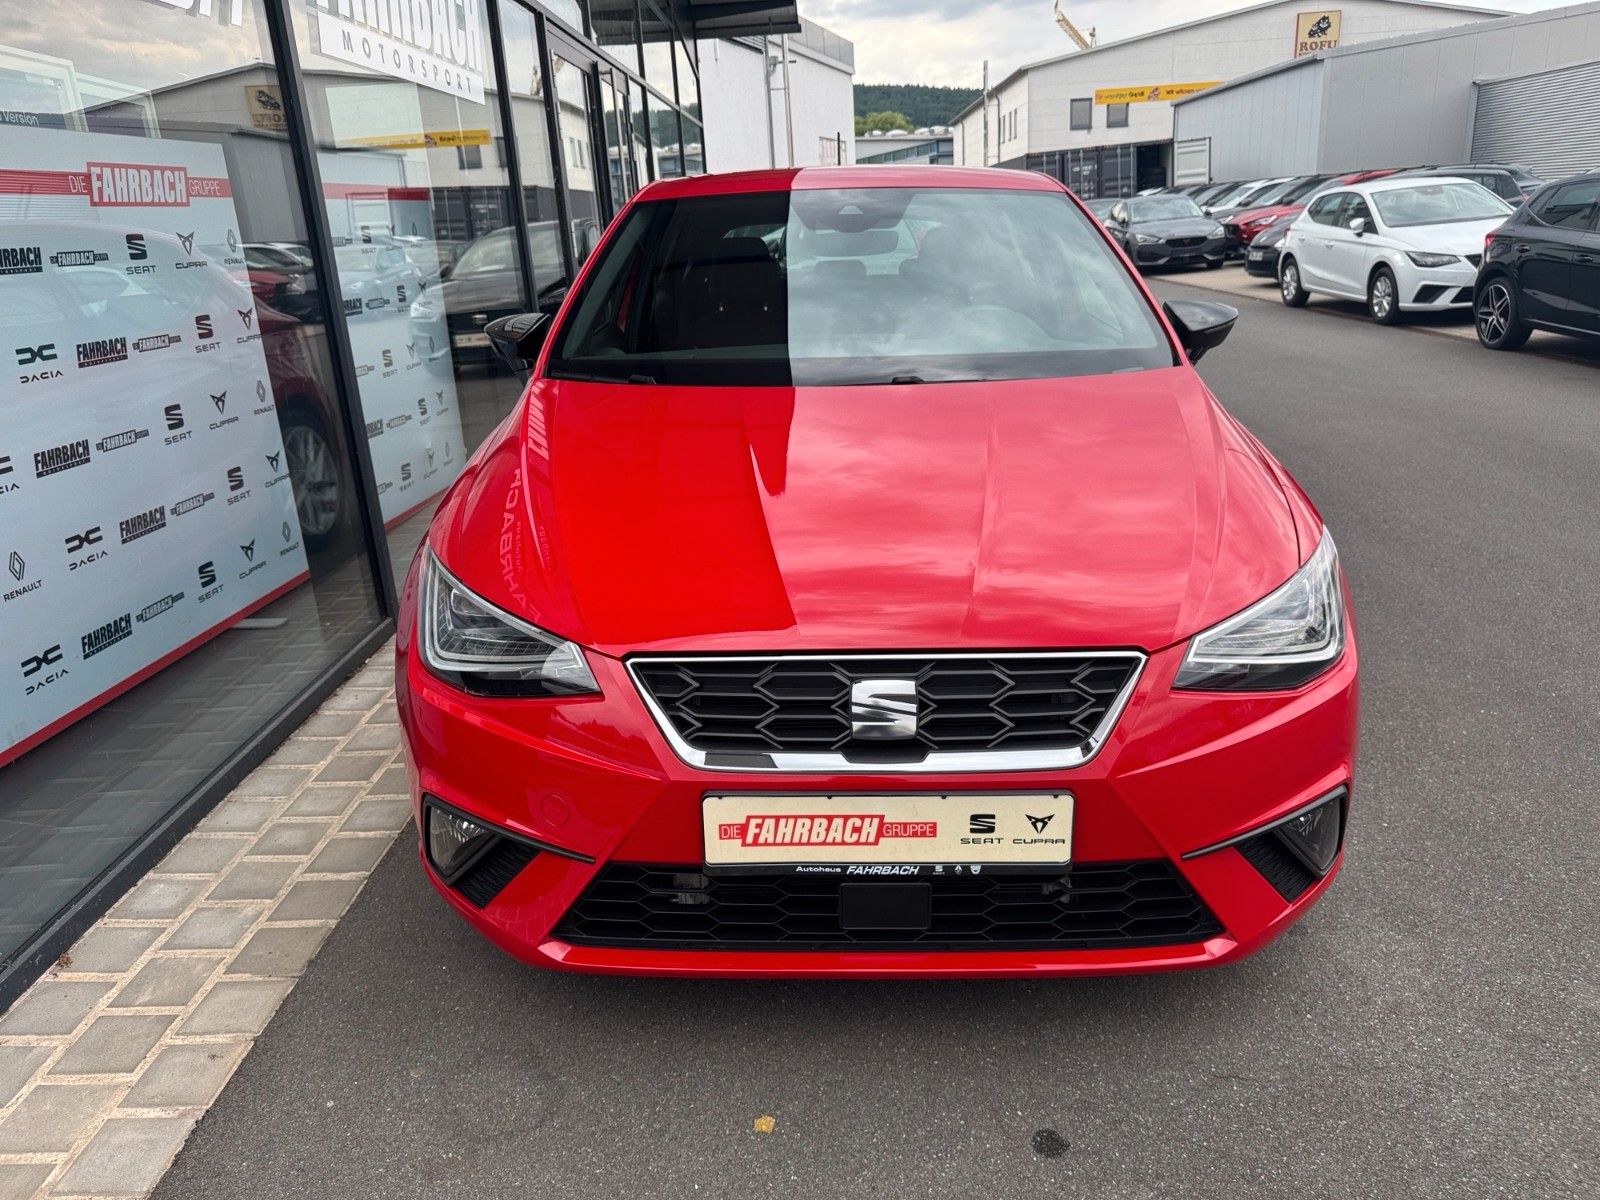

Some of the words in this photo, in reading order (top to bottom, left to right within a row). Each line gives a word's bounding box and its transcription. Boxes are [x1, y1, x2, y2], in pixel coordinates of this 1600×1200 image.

[1300, 40, 1338, 52] ROFU
[342, 29, 474, 94] MOTORSPORT
[3, 111, 40, 126] Version
[68, 175, 88, 193] DIE
[90, 166, 187, 203] FAHRBACH
[188, 179, 222, 196] GRUPPE
[58, 251, 94, 267] FAHRBACH
[175, 261, 208, 270] CUPRA
[126, 264, 157, 275] SEAT
[76, 337, 127, 362] FAHRBACH
[195, 342, 222, 354] SEAT
[20, 370, 64, 384] DACIA
[209, 416, 239, 430] CUPRA
[103, 430, 136, 452] FAHRBACH
[164, 430, 193, 446] SEAT
[34, 439, 90, 471] FAHRBACH
[227, 489, 251, 506] SEAT
[120, 505, 166, 539] FAHRBACH
[69, 550, 108, 571] DACIA
[4, 580, 43, 602] RENAULT
[198, 584, 224, 604] SEAT
[81, 613, 131, 653] FAHRBACH
[25, 668, 69, 695] DACIA
[720, 825, 741, 839] DIE
[745, 816, 879, 844] FAHRBACH
[883, 823, 935, 837] GRUPPE
[960, 837, 1004, 845] SEAT
[1012, 837, 1066, 845] CUPRA
[846, 865, 919, 875] FAHRBACH
